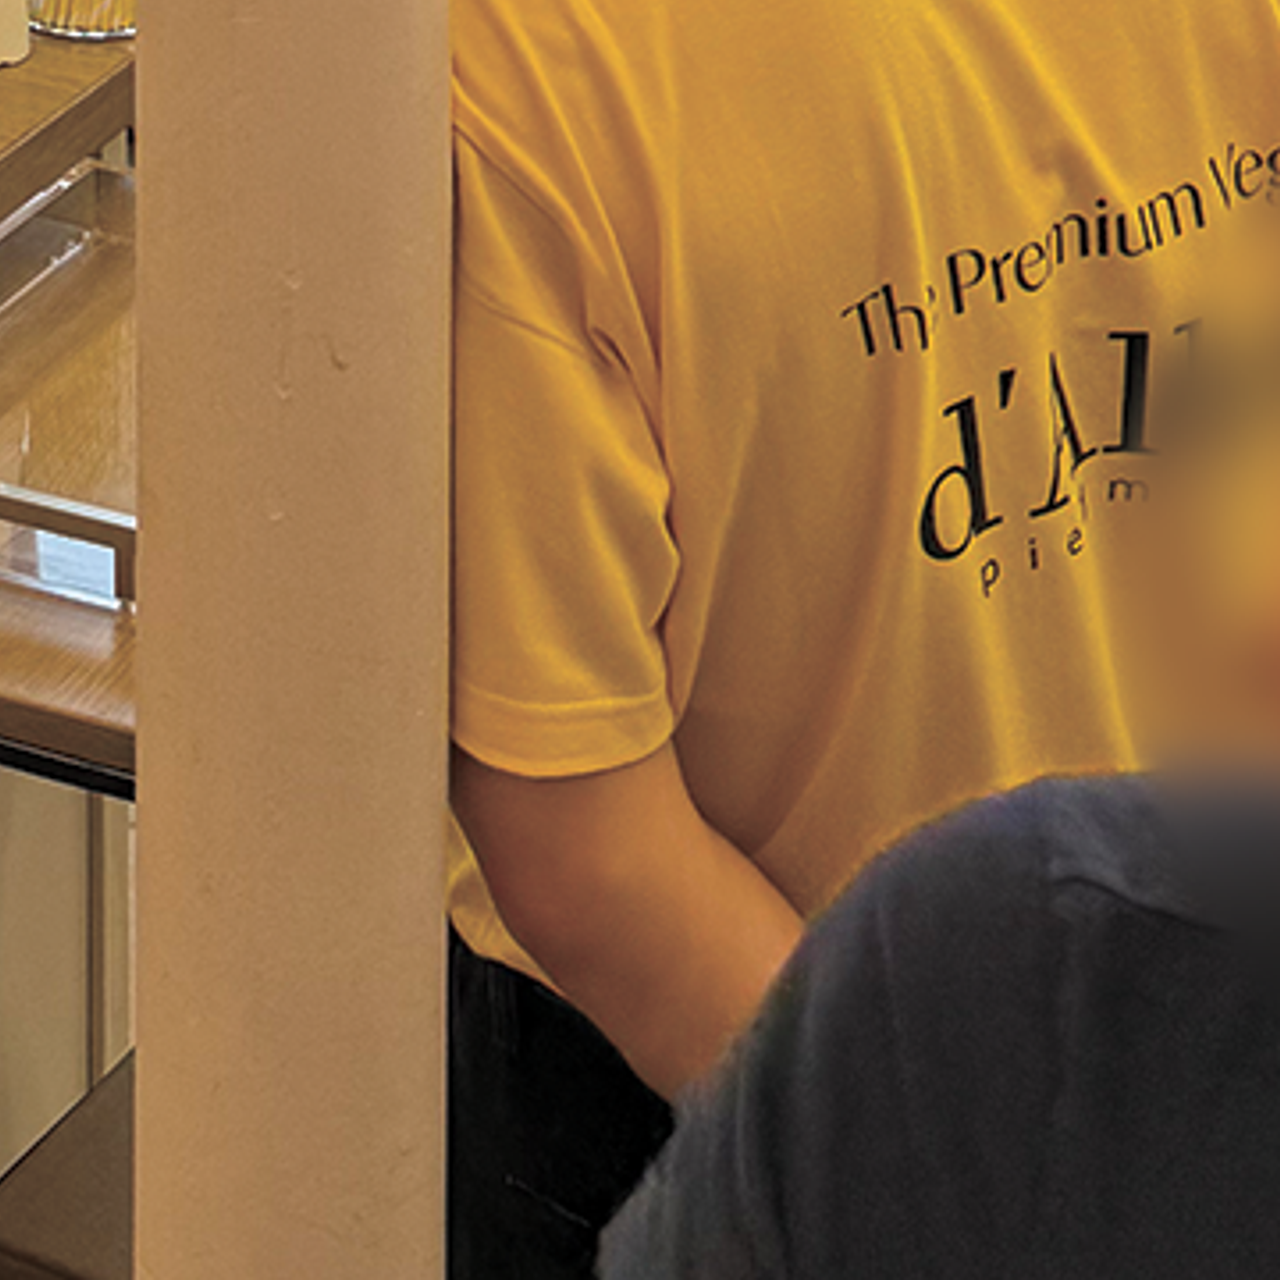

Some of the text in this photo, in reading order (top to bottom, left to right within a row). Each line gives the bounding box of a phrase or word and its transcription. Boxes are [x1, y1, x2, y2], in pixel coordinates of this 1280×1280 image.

[840, 282, 936, 357] Th
[946, 183, 1206, 316] Premium
[919, 320, 1204, 563] d'Al
